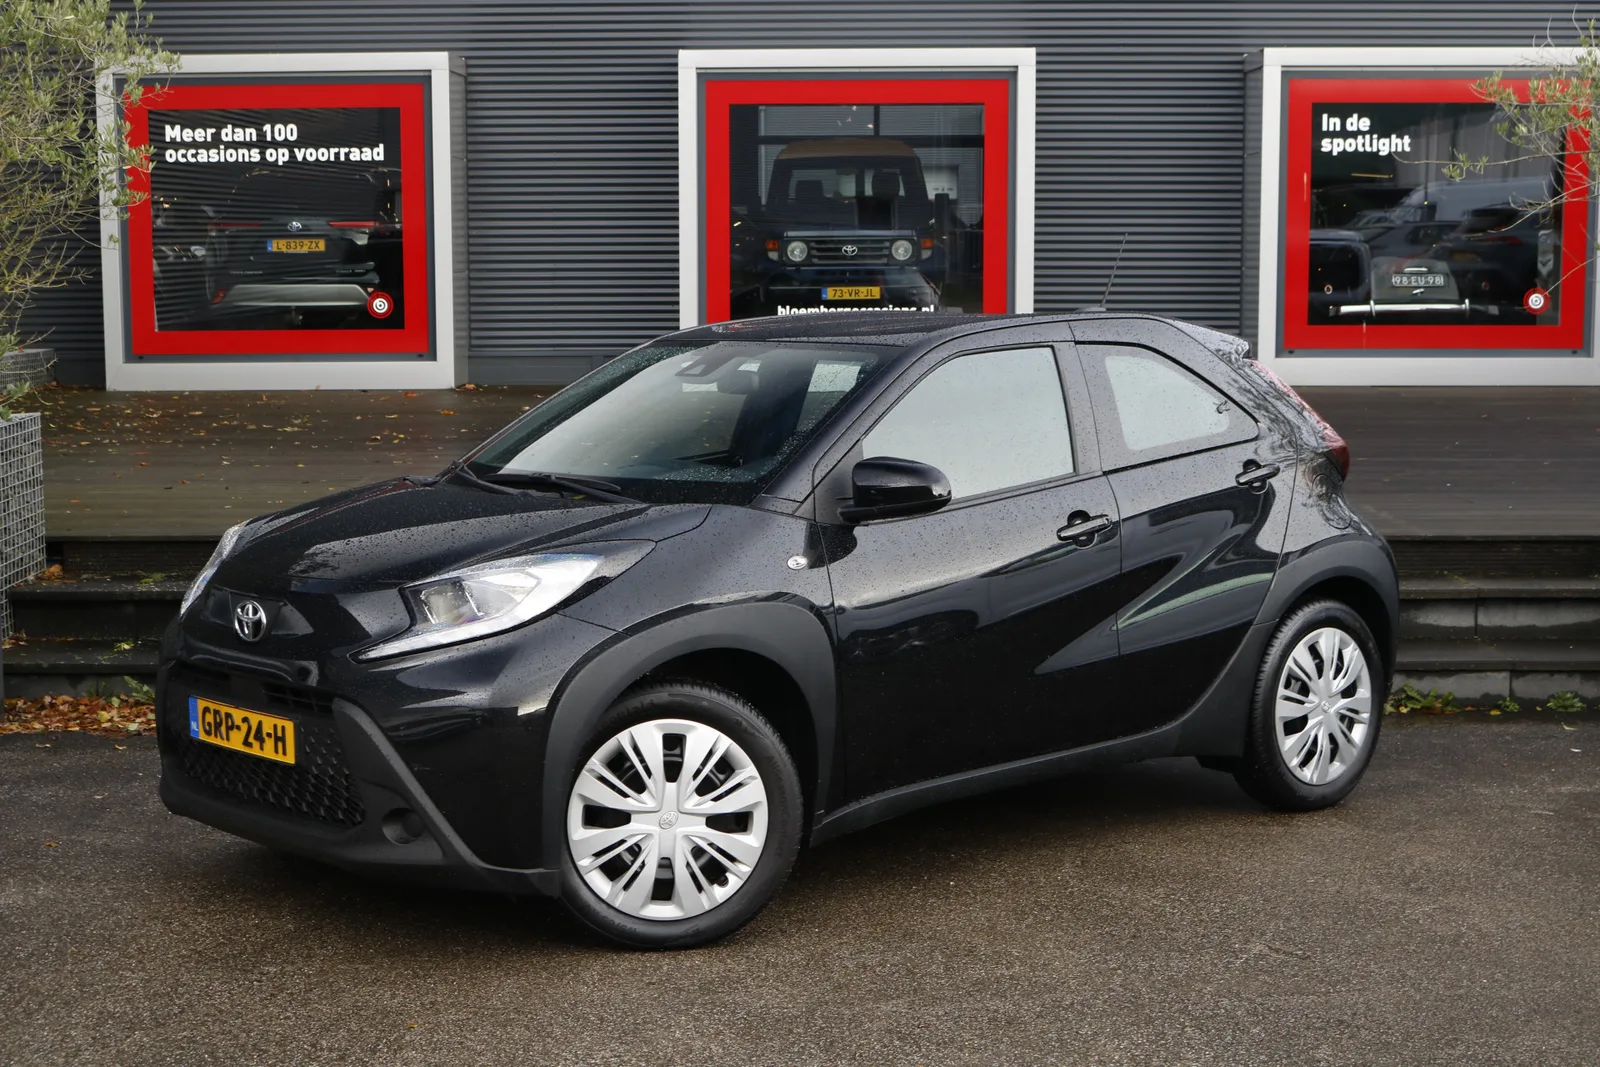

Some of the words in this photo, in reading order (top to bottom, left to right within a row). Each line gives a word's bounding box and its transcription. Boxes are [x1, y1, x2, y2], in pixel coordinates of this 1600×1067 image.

[1321, 113, 1341, 132] In
[1345, 112, 1371, 132] de
[164, 124, 217, 142] Meer
[220, 124, 257, 142] dan
[262, 123, 298, 142] 100
[164, 145, 261, 163] occasions
[265, 148, 290, 165] op
[293, 143, 385, 162] voorraad
[1320, 133, 1412, 156] spotlight
[276, 240, 320, 251] L-839-ZX
[831, 288, 876, 299] 73-VR-JL
[201, 705, 288, 757] GRP-24-H
